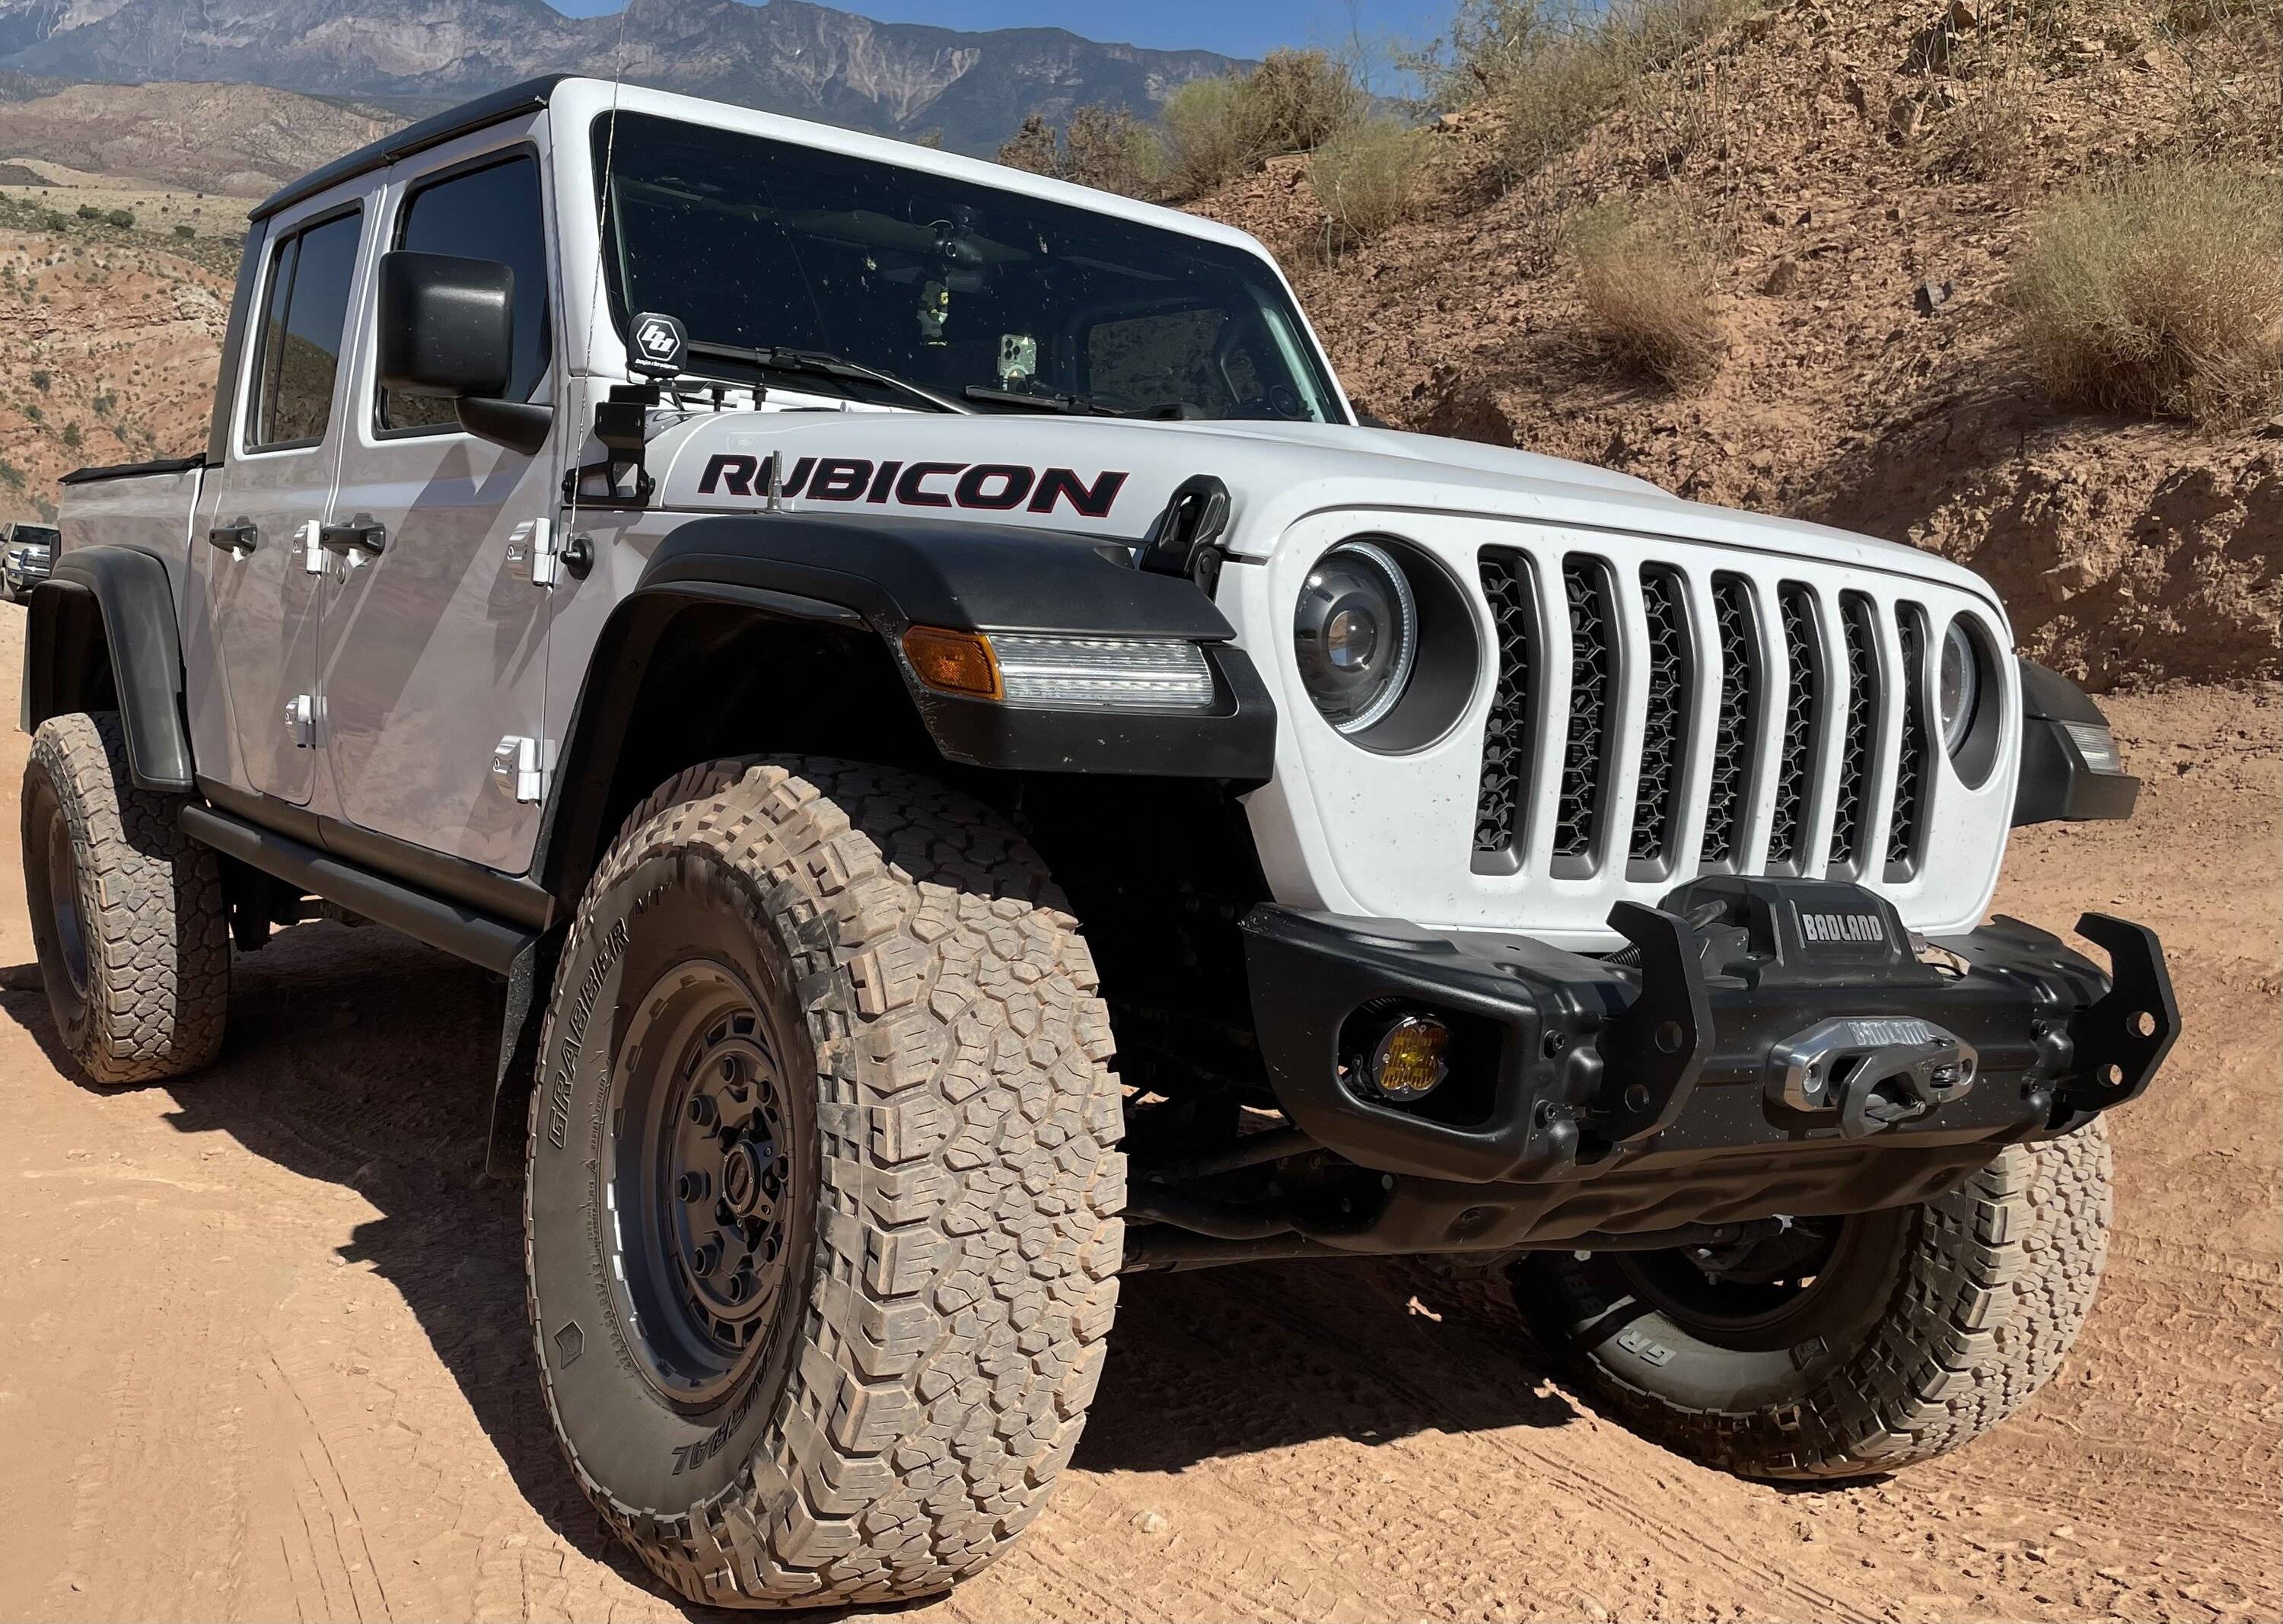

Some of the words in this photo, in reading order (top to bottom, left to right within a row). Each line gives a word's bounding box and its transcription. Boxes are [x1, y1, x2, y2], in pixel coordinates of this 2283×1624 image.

[697, 454, 1130, 518] RUBICON
[1801, 913, 1883, 942] BADLAND
[549, 916, 629, 1149] GRABBER
